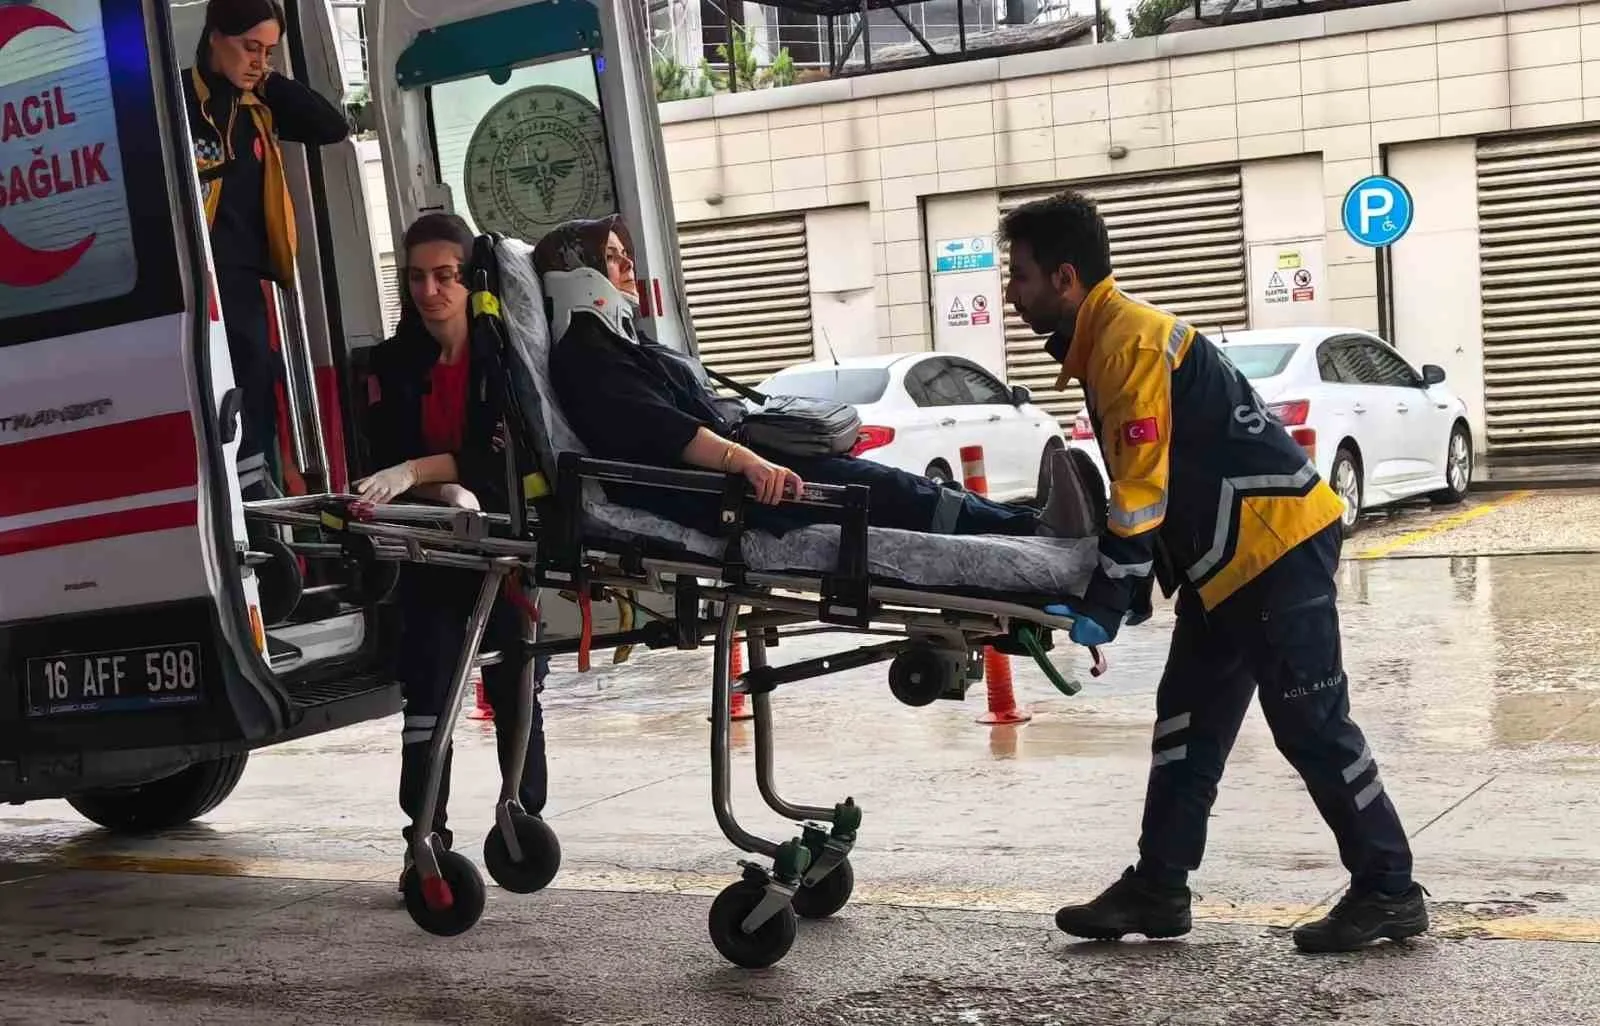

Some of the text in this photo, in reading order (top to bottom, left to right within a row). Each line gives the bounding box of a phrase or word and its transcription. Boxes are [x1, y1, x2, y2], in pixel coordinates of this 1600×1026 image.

[1360, 187, 1394, 235] P
[44, 649, 195, 699] 16 AFF 598
